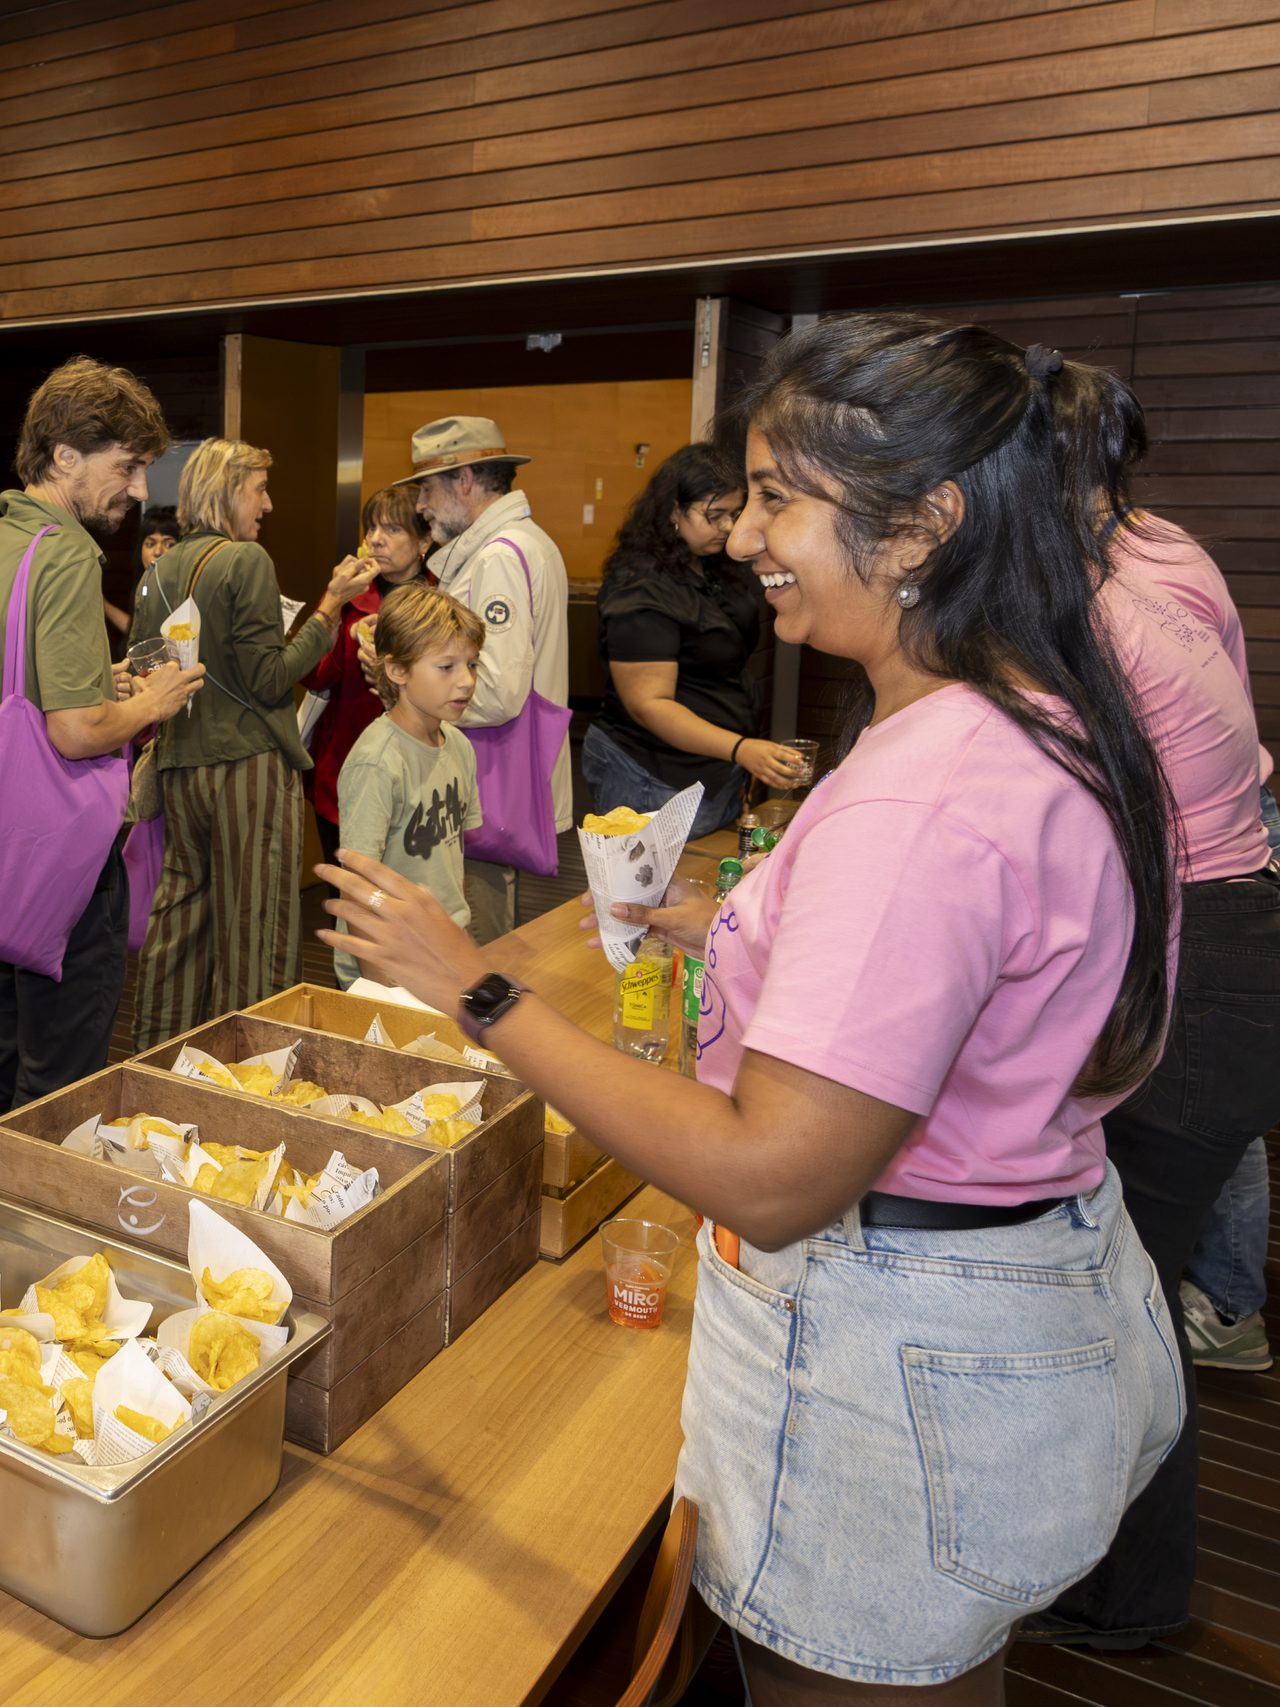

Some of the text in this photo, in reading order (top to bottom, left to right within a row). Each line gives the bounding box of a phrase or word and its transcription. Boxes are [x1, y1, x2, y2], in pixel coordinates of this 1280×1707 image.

[621, 974, 659, 992] Schweppes
[613, 1284, 660, 1306] MIRO
[614, 1299, 658, 1314] VERMOUTH
